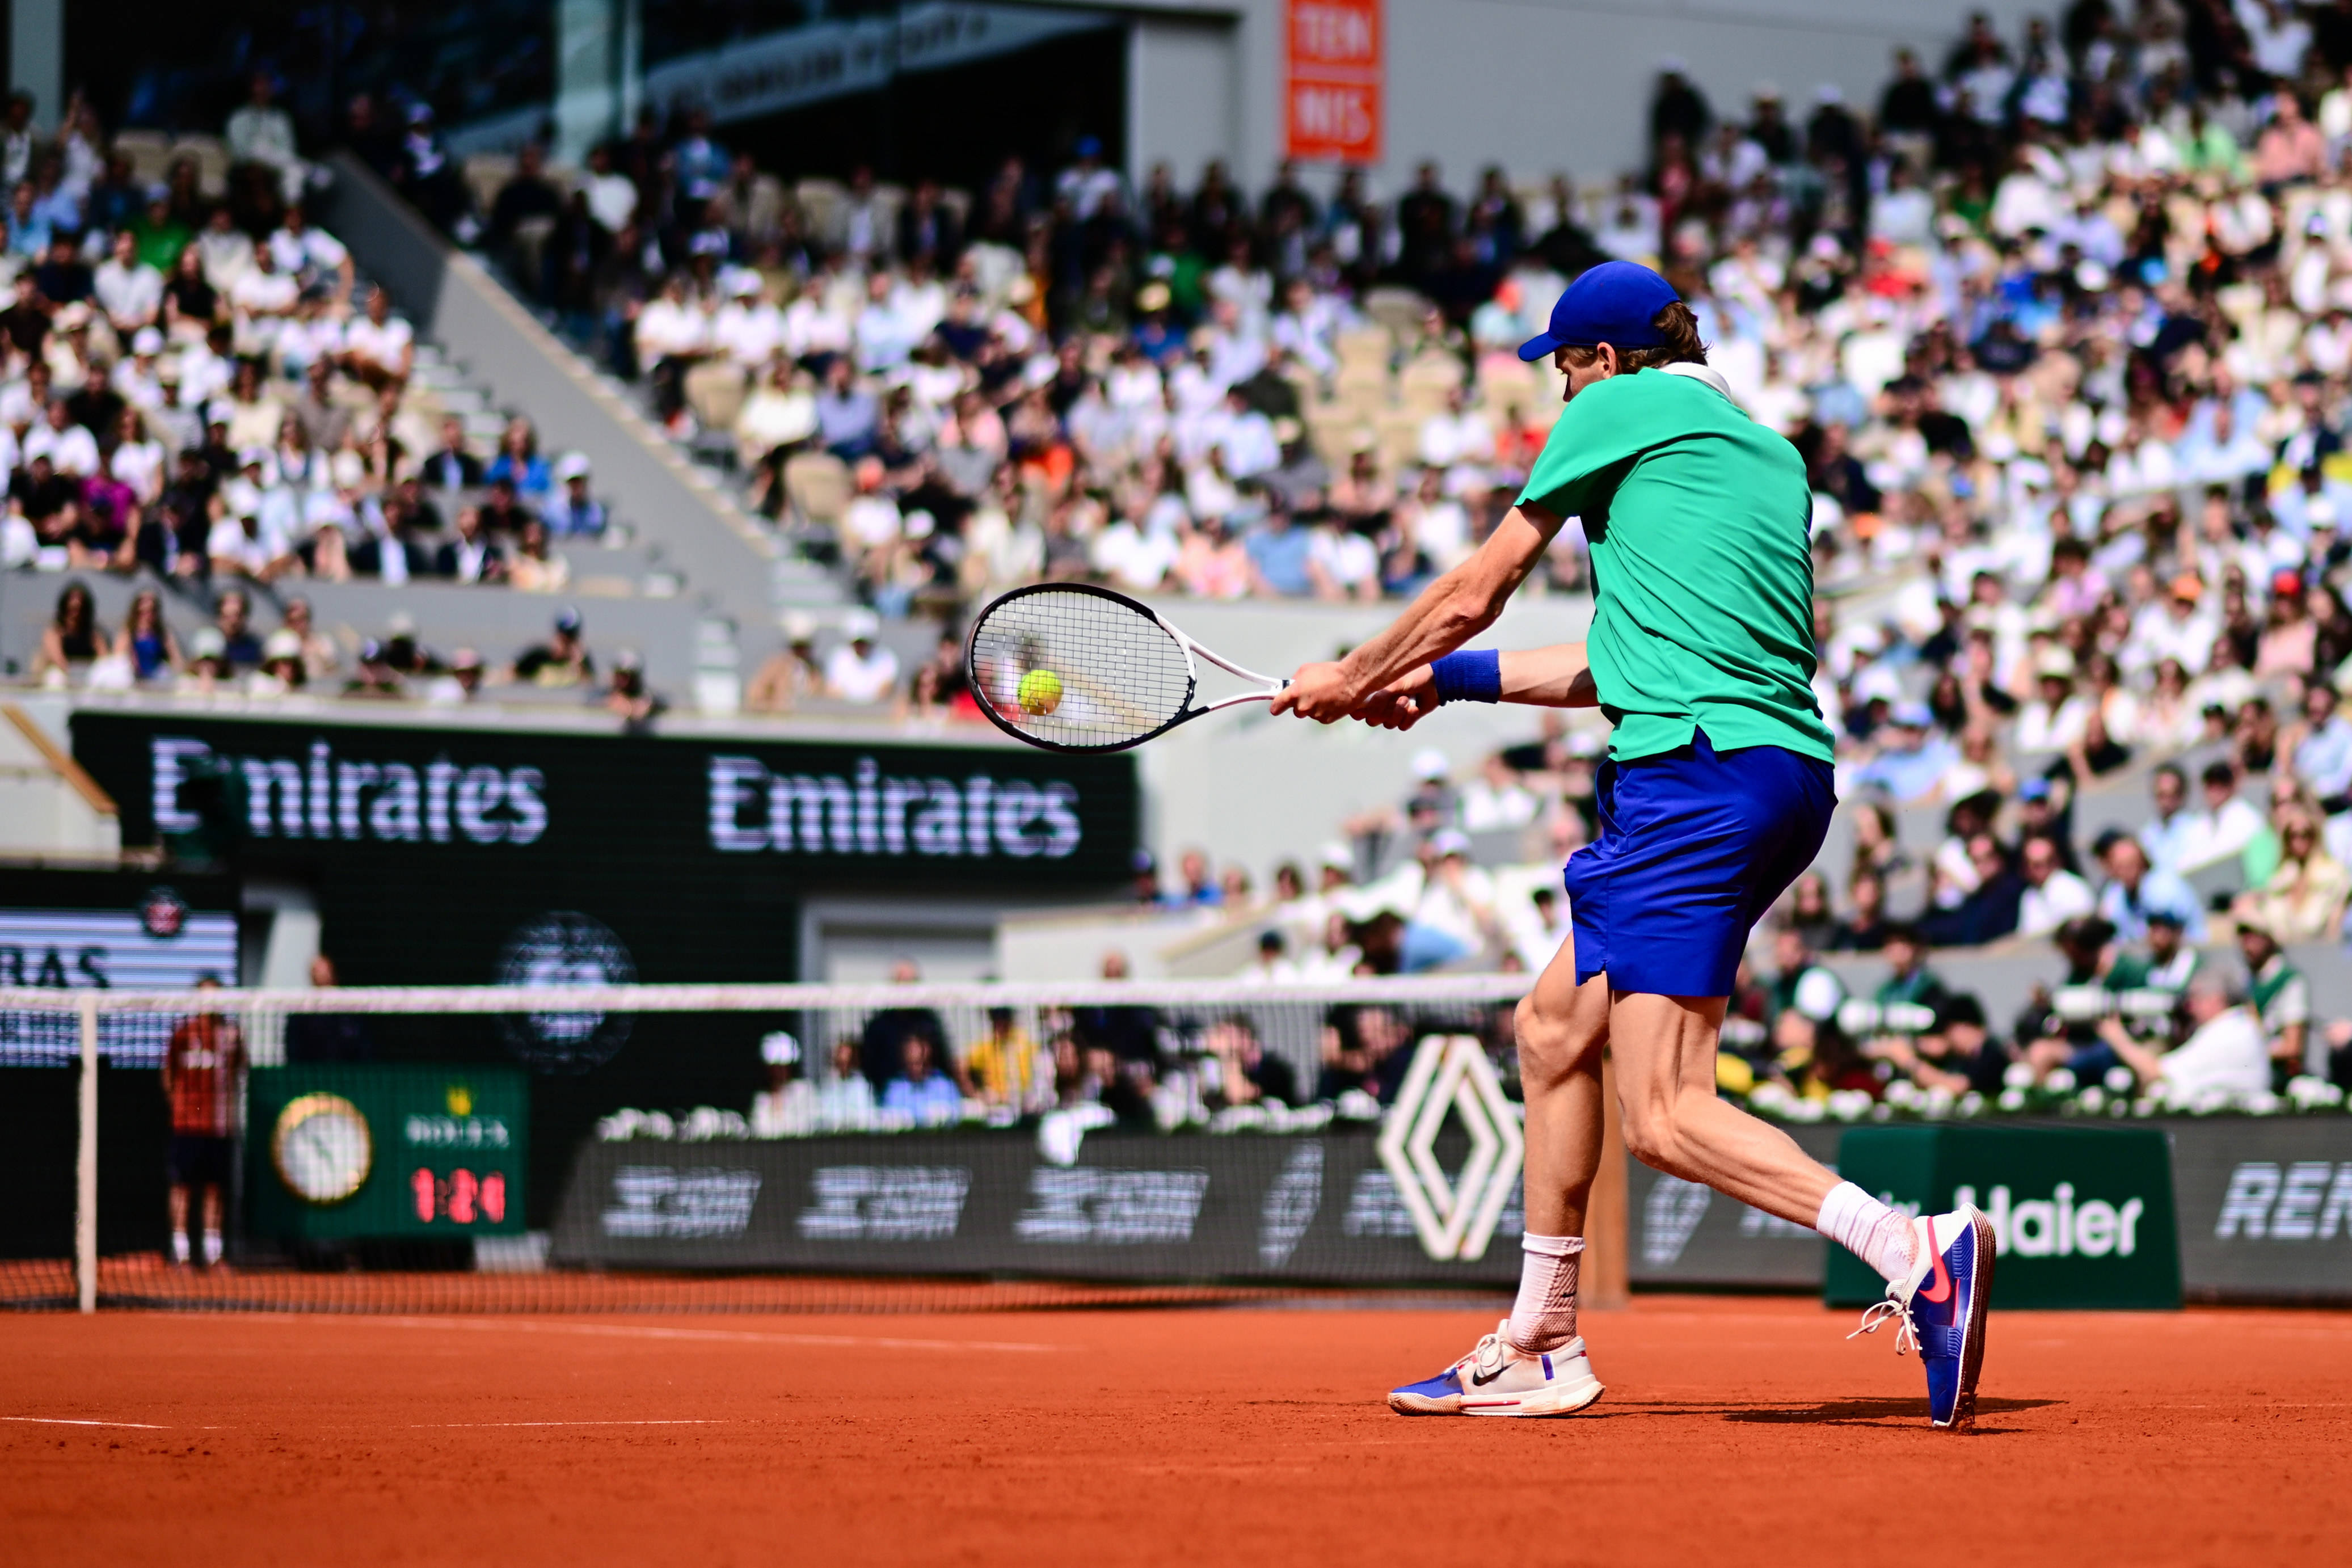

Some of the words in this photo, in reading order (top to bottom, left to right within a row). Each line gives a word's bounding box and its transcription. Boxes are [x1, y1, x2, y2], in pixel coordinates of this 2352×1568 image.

[1296, 6, 1371, 56] TEN
[1296, 88, 1371, 143] NIS
[709, 756, 1081, 858] Emirates
